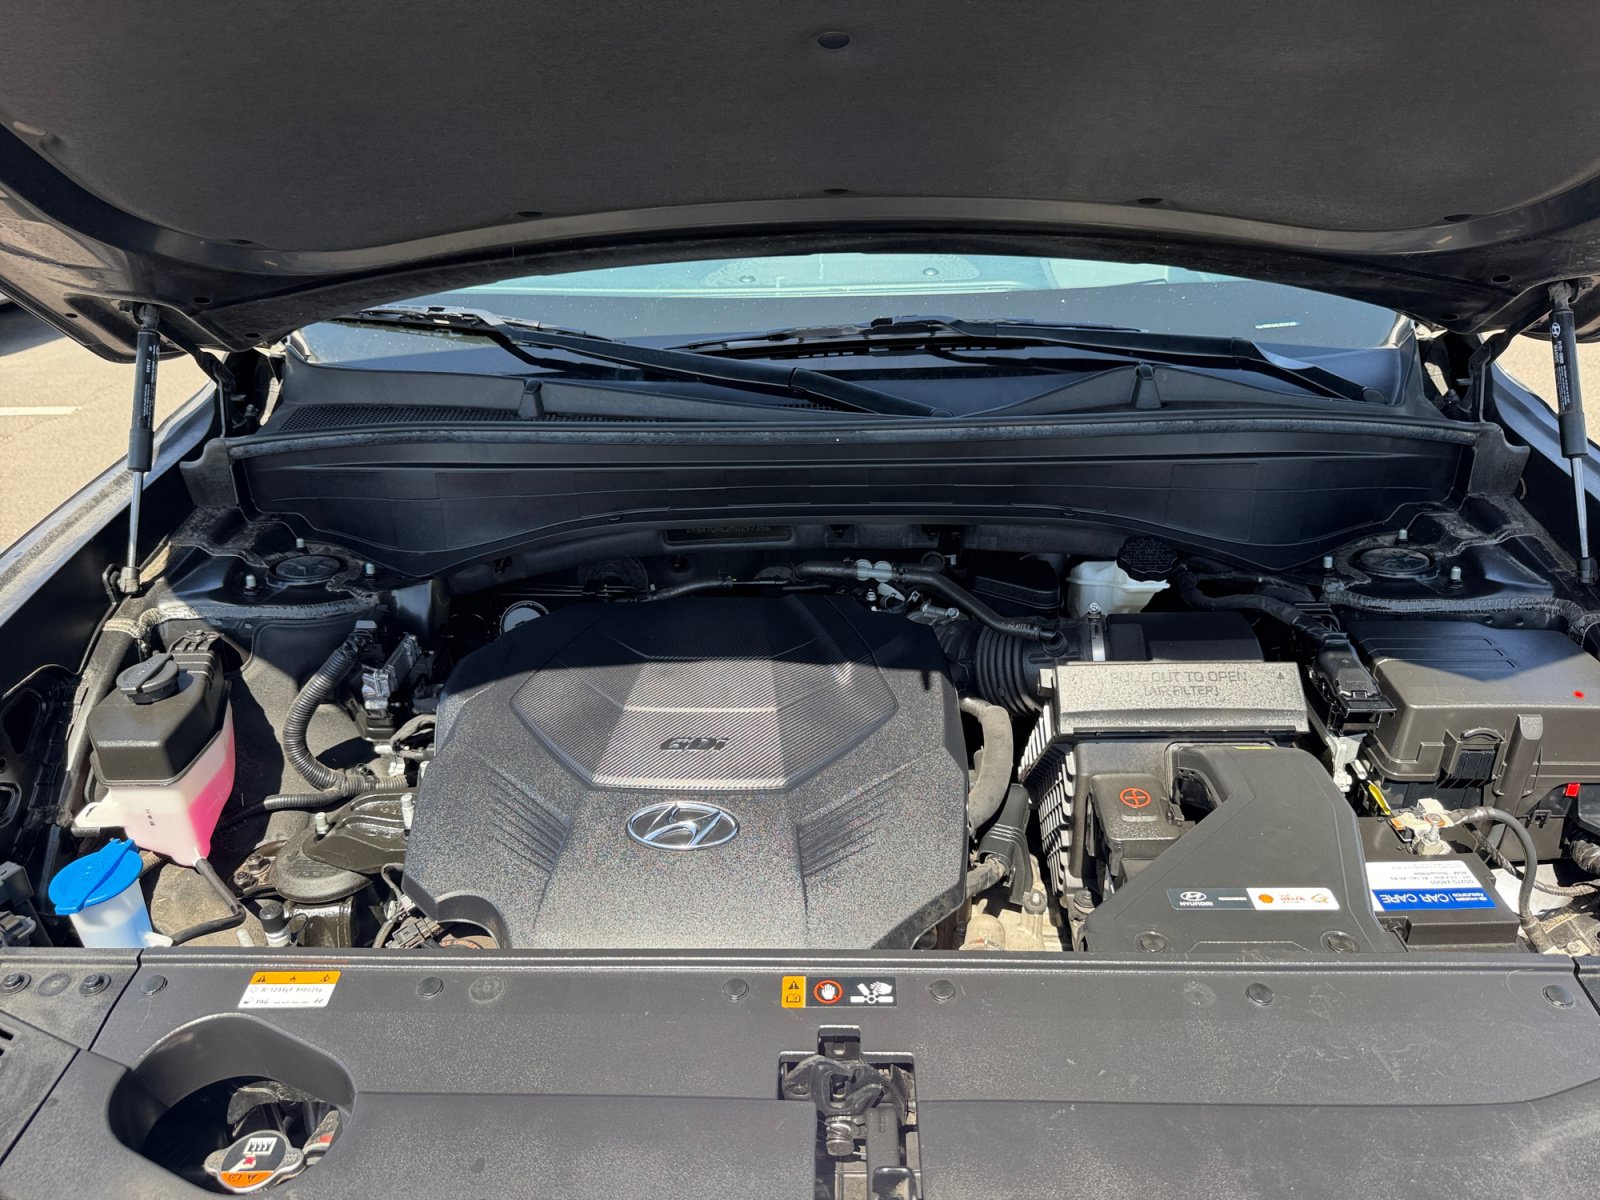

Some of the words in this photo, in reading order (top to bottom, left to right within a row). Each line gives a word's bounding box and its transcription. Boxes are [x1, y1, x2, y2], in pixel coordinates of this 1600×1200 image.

[1151, 671, 1181, 683] OUT
[1184, 671, 1204, 682] TO
[1207, 671, 1247, 682] OPEN
[1380, 894, 1418, 903] CARE
[1419, 893, 1449, 903] CAR
